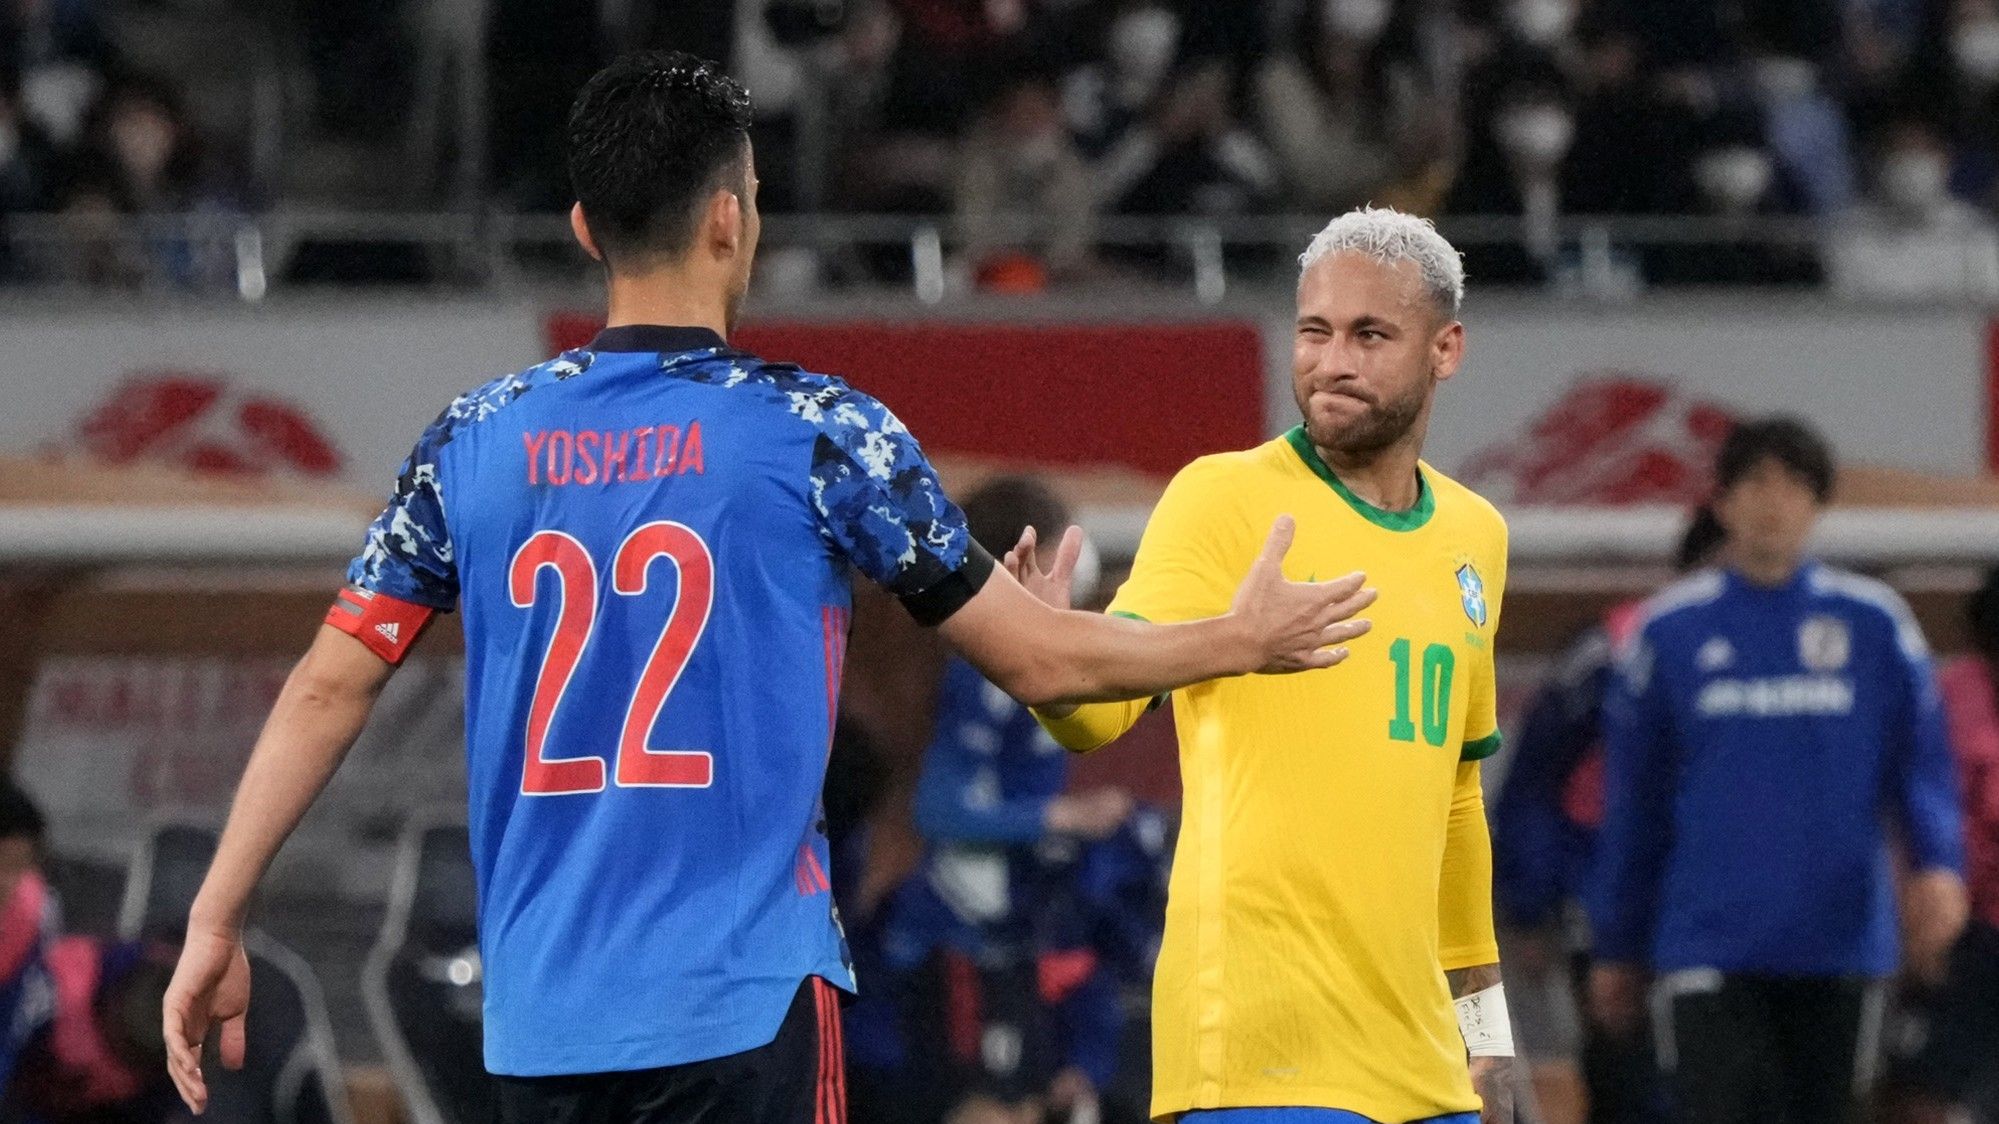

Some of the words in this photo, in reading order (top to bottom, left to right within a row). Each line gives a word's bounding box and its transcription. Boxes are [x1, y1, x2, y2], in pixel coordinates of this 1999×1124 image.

[523, 420, 705, 486] YOSHIDA
[508, 520, 714, 796] 22
[1388, 637, 1455, 748] 10
